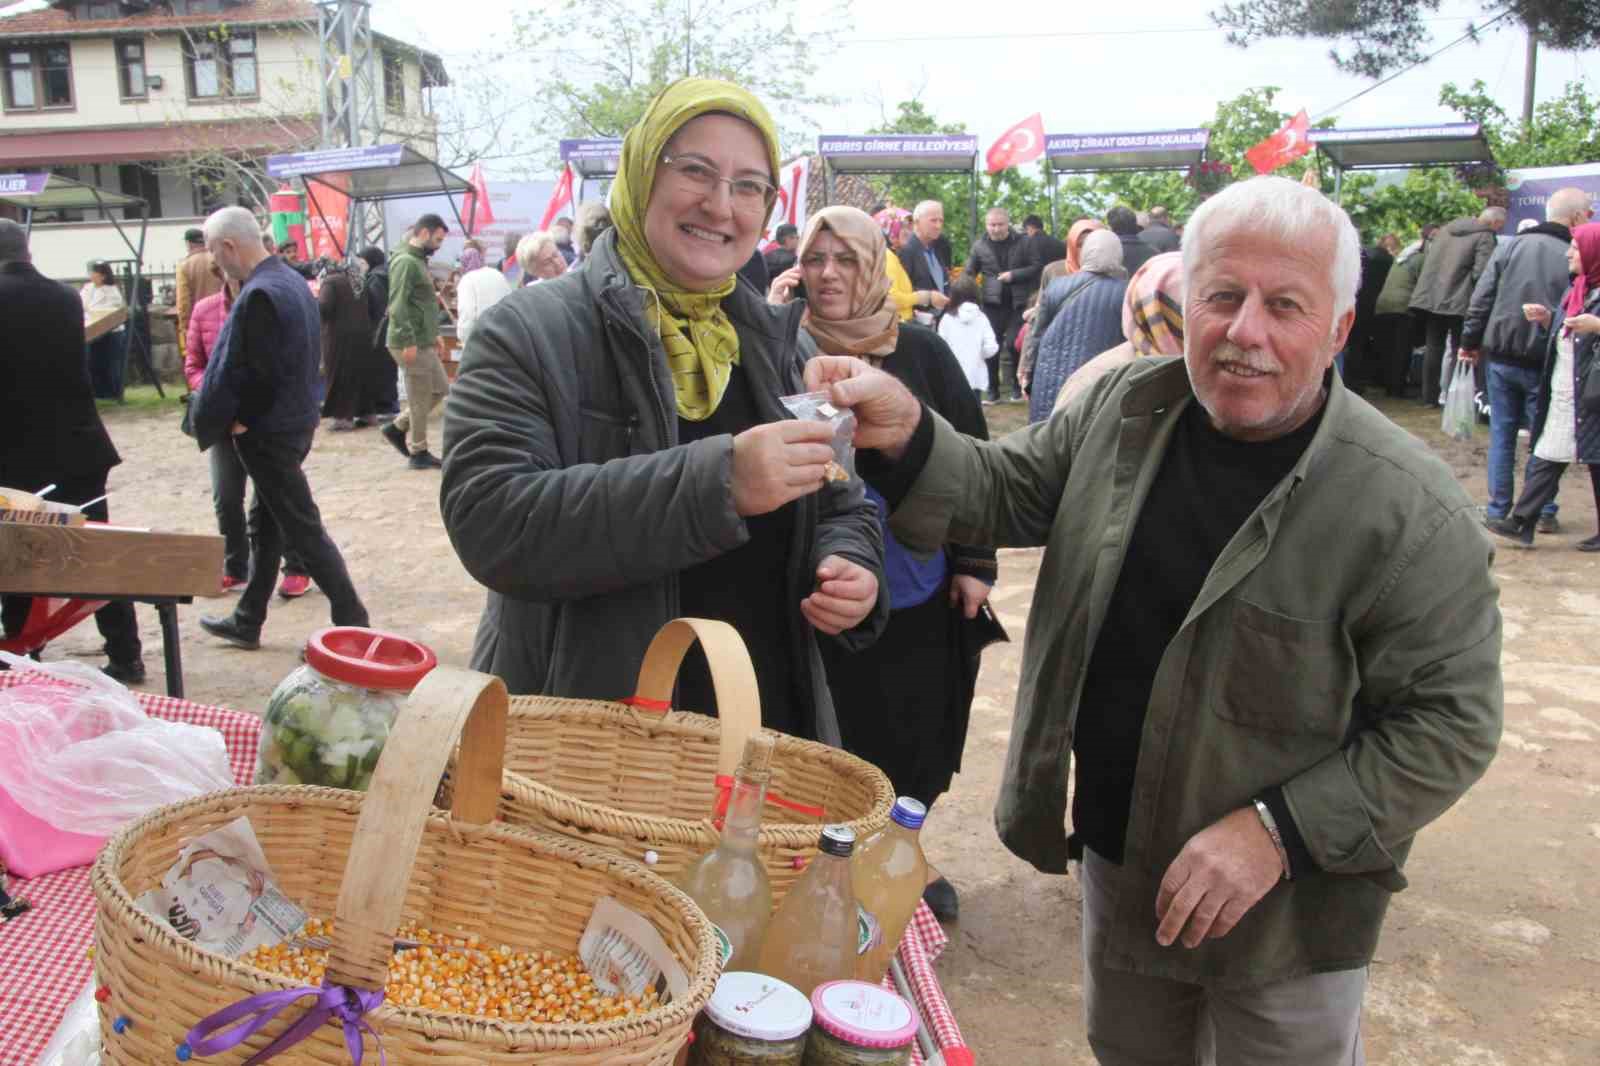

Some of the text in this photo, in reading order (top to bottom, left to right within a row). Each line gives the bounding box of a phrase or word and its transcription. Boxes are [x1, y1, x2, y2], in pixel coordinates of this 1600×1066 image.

[822, 139, 975, 152] KIBRIS GİRNE BELEDİYESİ
